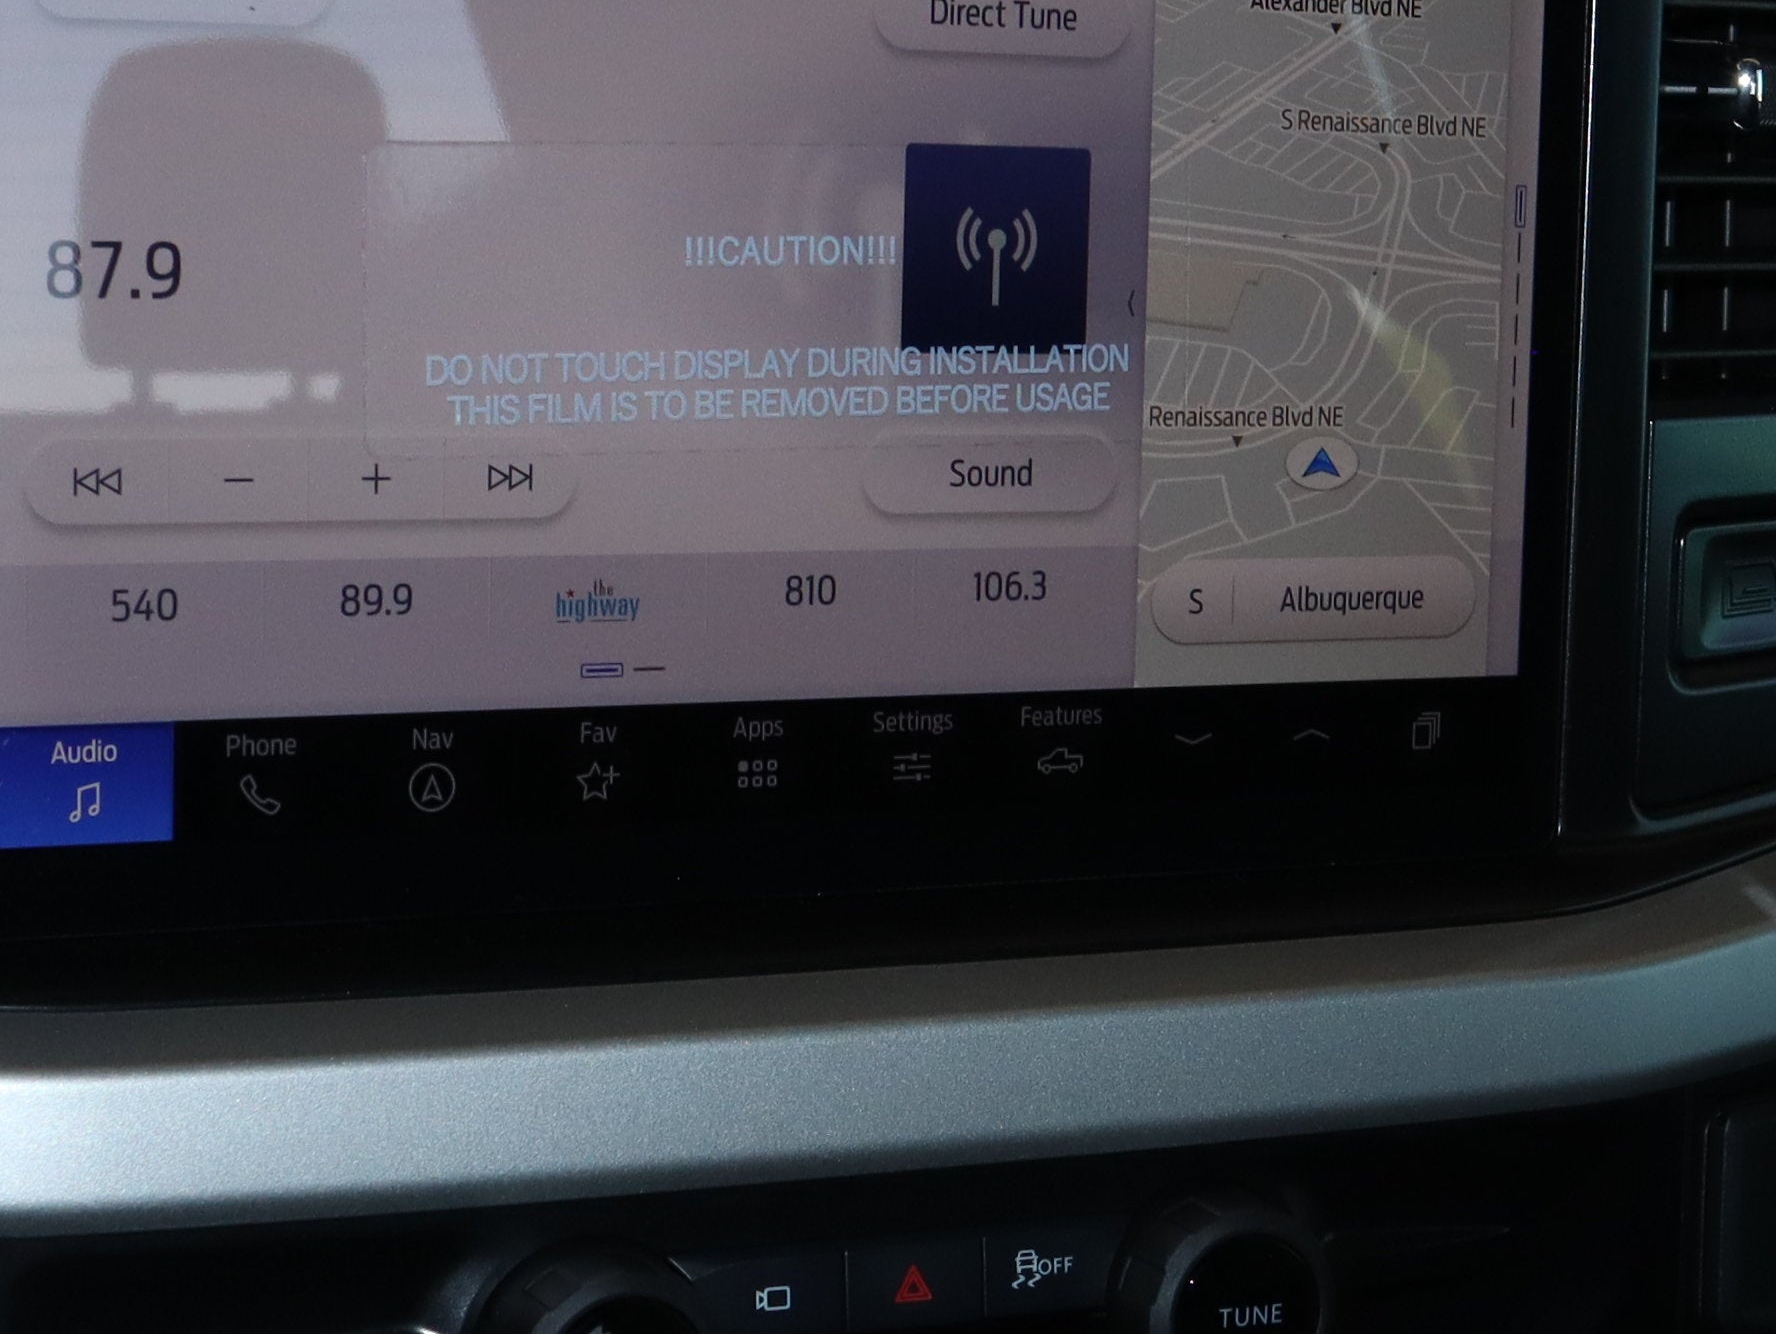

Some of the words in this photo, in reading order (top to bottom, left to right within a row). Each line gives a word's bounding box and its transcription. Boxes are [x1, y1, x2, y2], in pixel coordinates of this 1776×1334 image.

[1014, 0, 1078, 32] Tune
[1281, 109, 1293, 131] S
[1298, 109, 1412, 136] Renaissance
[1417, 113, 1458, 137] Blvd
[1461, 116, 1487, 139] NE
[685, 234, 897, 267] !!!CAUTION!!!
[45, 240, 182, 301] 87.9
[426, 354, 473, 386] DO
[481, 353, 549, 384] NOT
[555, 350, 666, 382] TOUCH
[674, 348, 800, 380] DISPLAY
[808, 346, 922, 378] DURING
[929, 343, 1129, 375] INSTALLATION
[447, 394, 520, 425] THIS
[528, 393, 602, 424] FILM
[611, 391, 637, 422] IS
[644, 390, 687, 421] TO
[695, 389, 735, 420] BE
[742, 386, 889, 417] REMOVED
[897, 384, 1010, 415] BEFORE
[1016, 382, 1111, 413] USAGE
[1149, 406, 1266, 429] Renaissance
[1271, 406, 1313, 429] Blvd
[1316, 407, 1344, 428] NE
[949, 459, 1034, 489] Sound
[340, 583, 413, 618] 89.9
[593, 578, 614, 597] the
[784, 574, 837, 607] 810
[973, 570, 1047, 603] 106.3
[1280, 585, 1425, 617] Albuquerque
[110, 588, 178, 623] 540
[555, 589, 640, 623] highway
[1188, 588, 1204, 616] S
[733, 717, 784, 743] Apps
[873, 709, 954, 736] Settings
[1021, 705, 1103, 729] Features
[226, 734, 297, 759] Phone
[412, 728, 454, 751] Nav
[580, 722, 618, 745] Fav
[50, 740, 118, 765] Audio
[1038, 1256, 1073, 1276] OFF
[1219, 1303, 1284, 1328] TUNE
